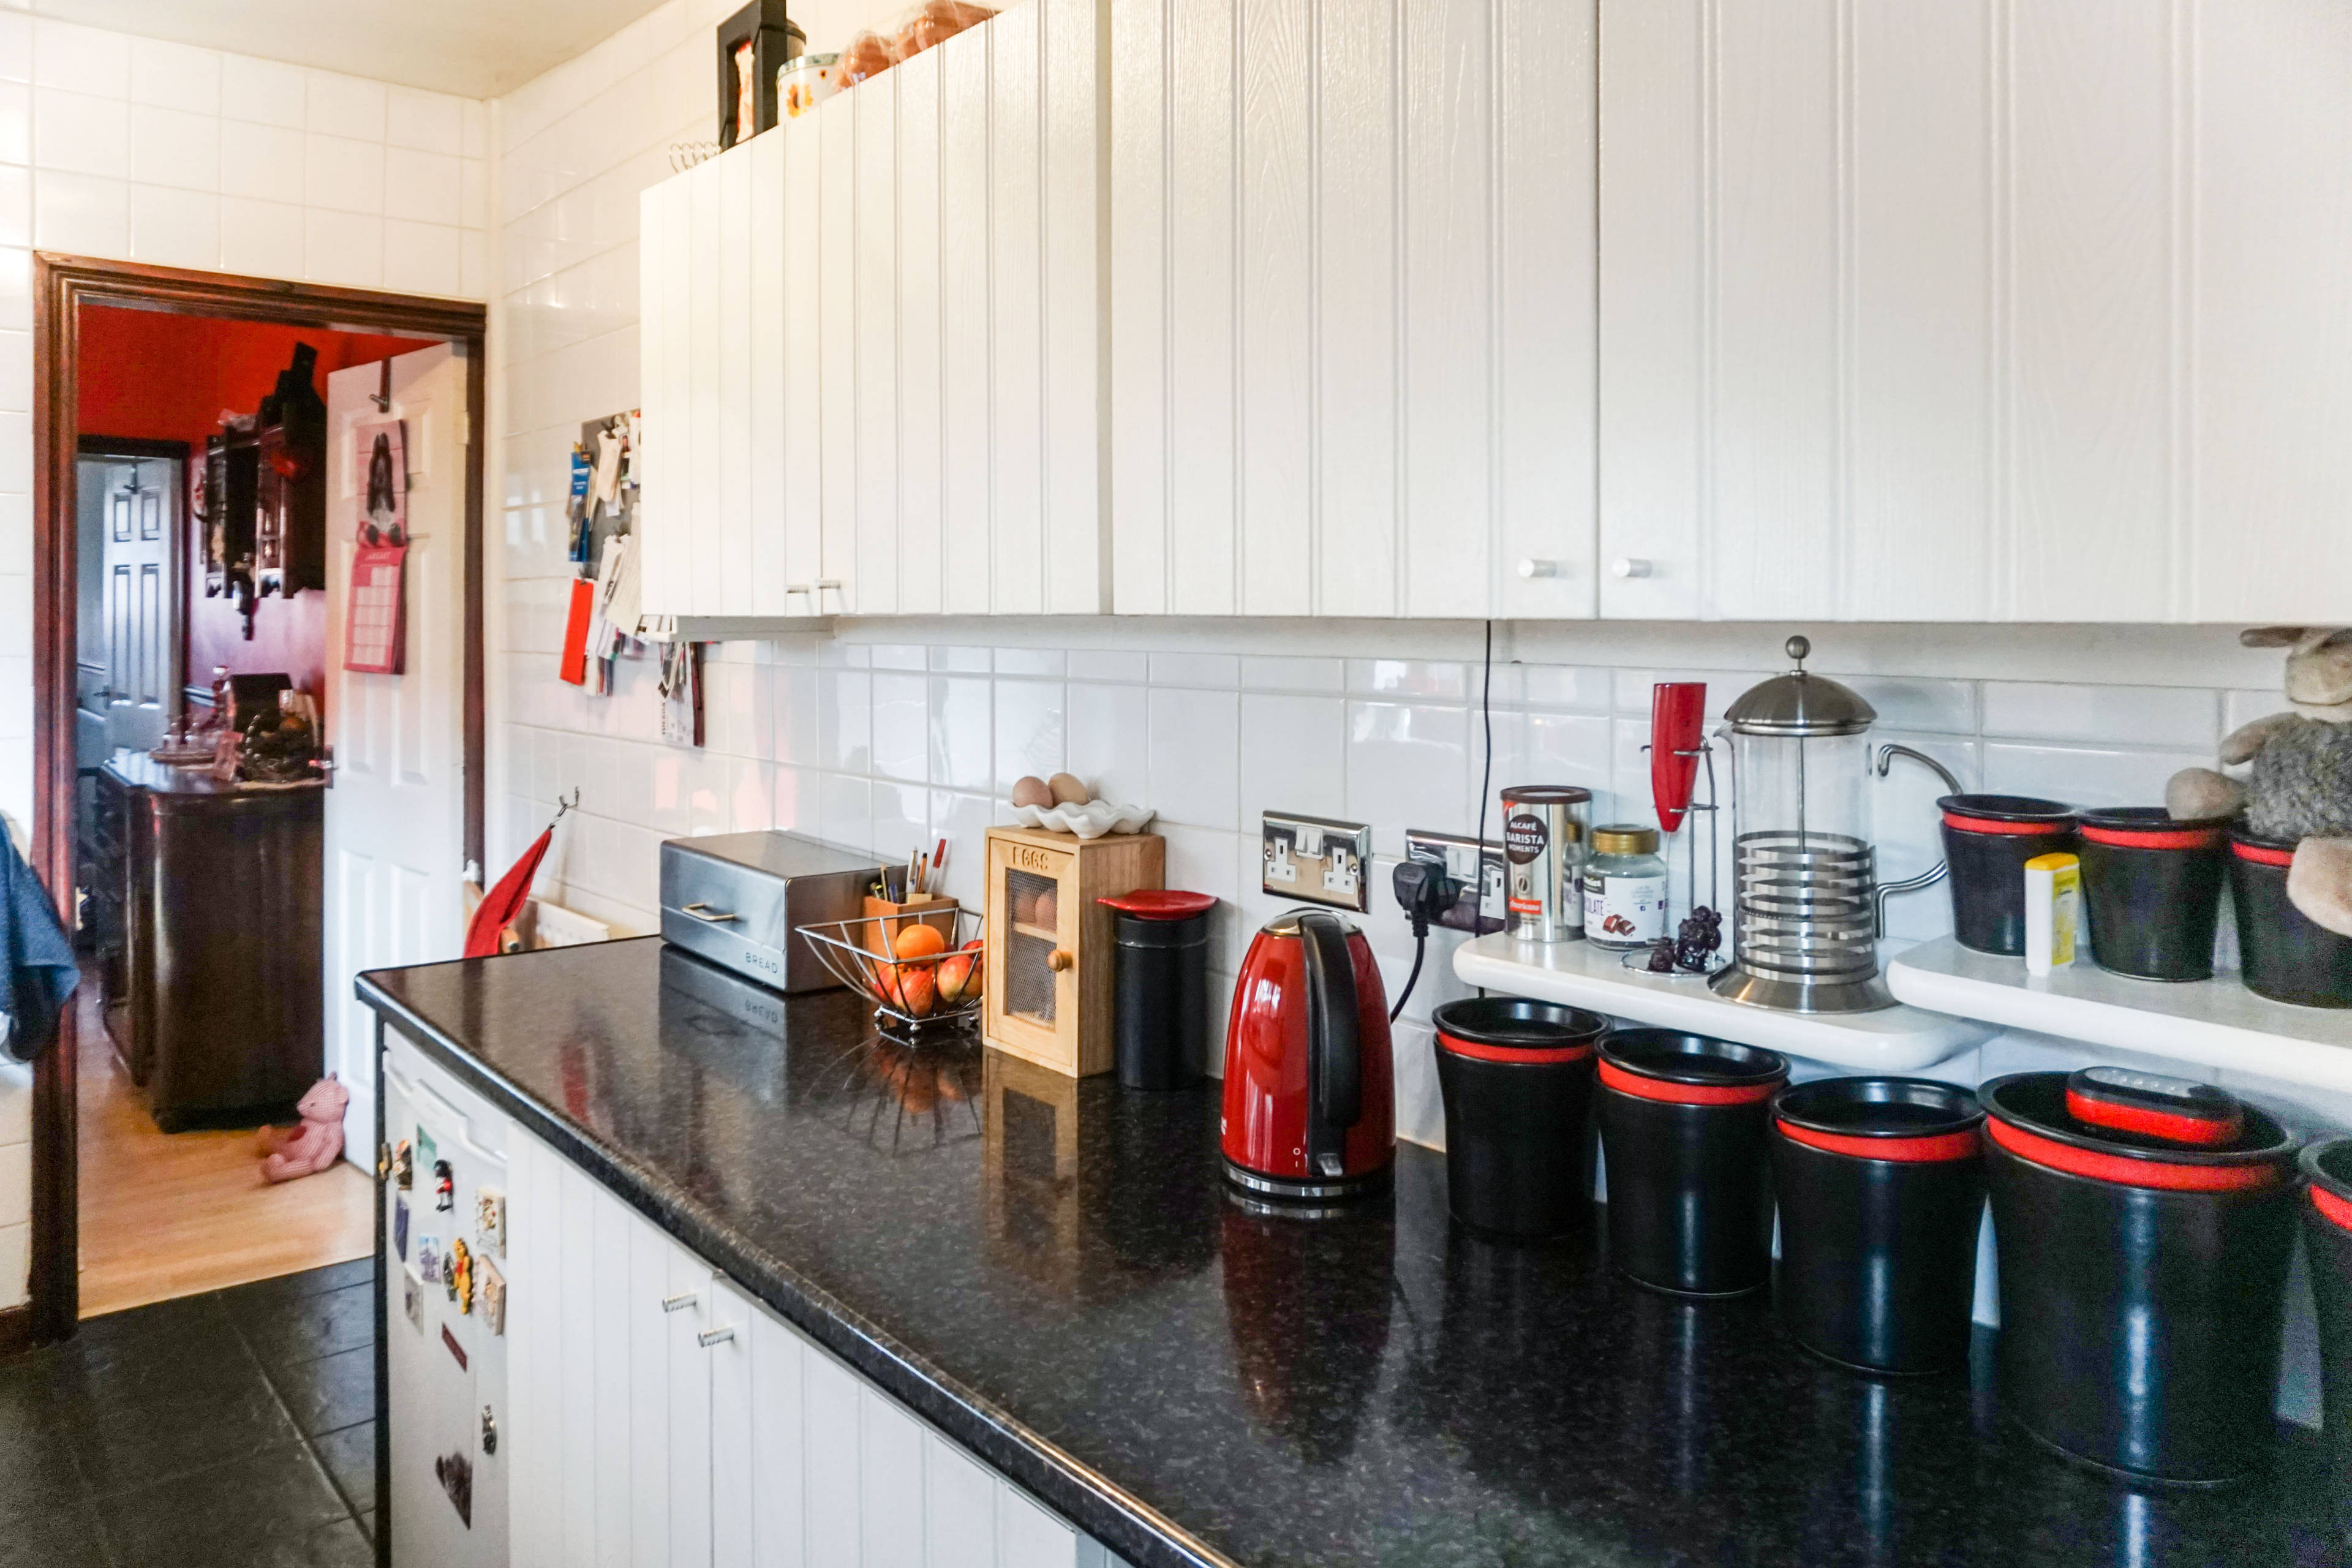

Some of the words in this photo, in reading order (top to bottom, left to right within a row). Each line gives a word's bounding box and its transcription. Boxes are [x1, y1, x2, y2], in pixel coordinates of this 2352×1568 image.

[1510, 821, 1537, 831] ALCAFÉ
[1507, 832, 1544, 845] BARISTA
[1509, 844, 1539, 853] MOMENTS
[1013, 846, 1048, 870] EGGS
[745, 952, 778, 974] BREAD
